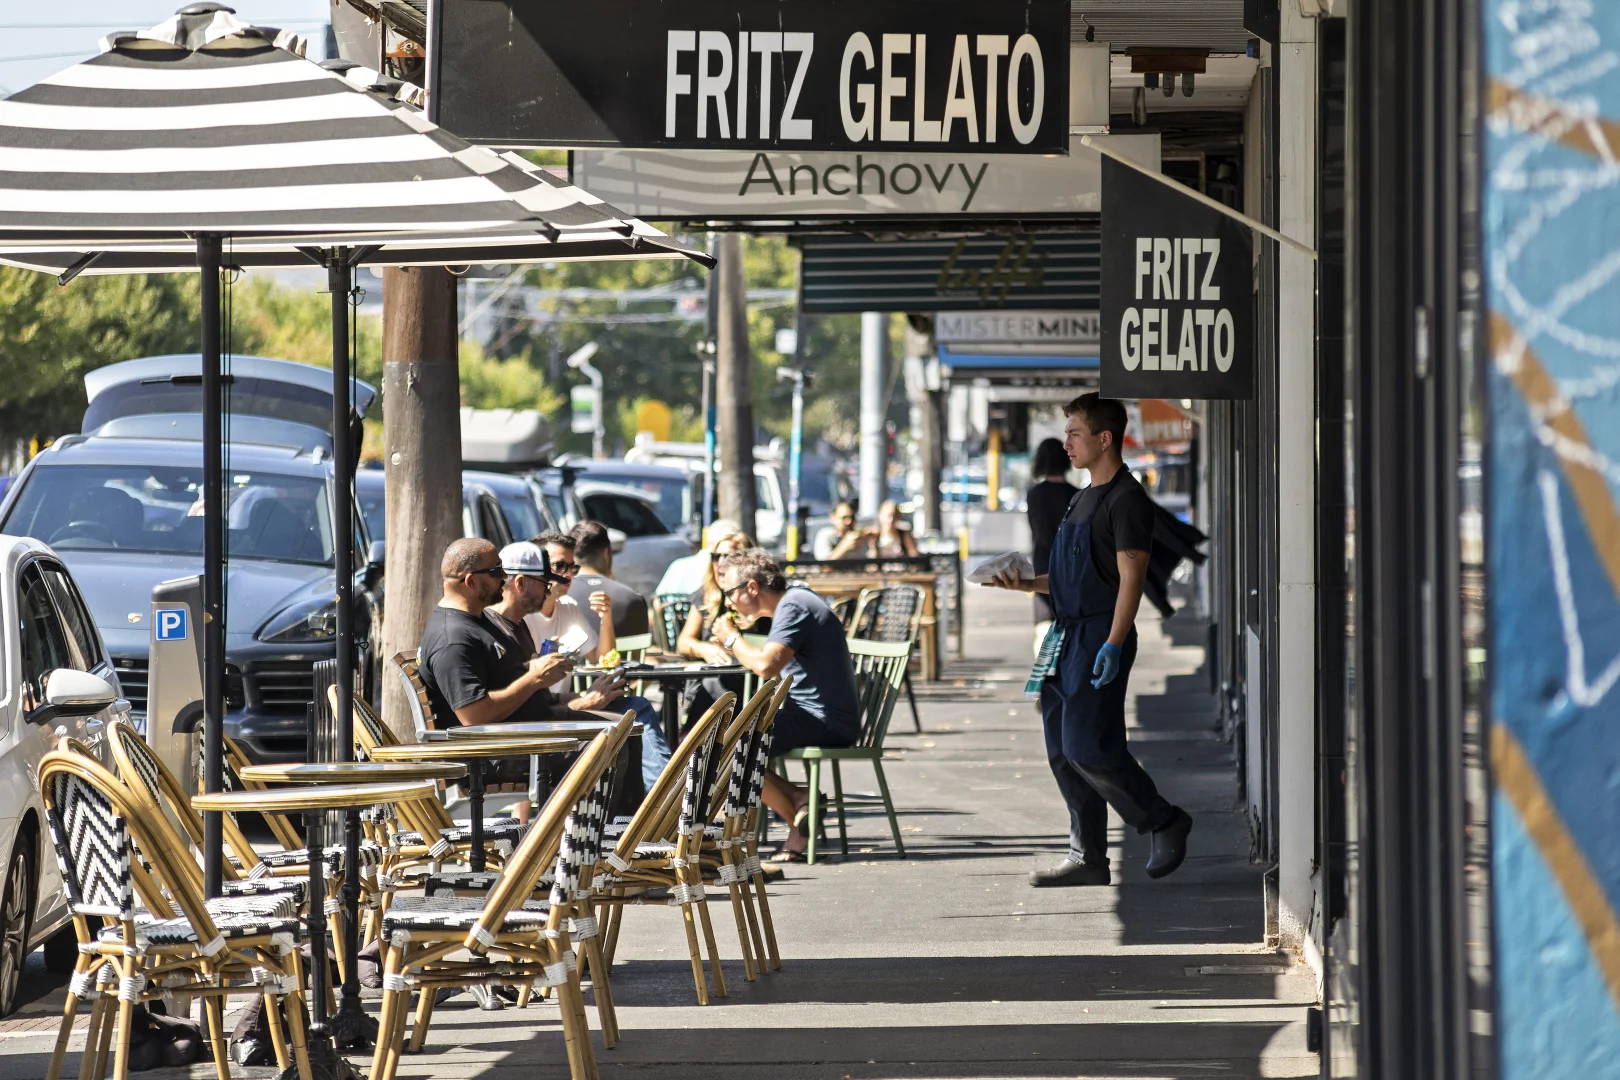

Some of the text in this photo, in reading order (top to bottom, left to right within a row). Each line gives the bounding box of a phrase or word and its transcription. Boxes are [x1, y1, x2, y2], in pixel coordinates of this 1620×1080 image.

[666, 30, 1045, 145] FRITZ GELATO
[738, 152, 989, 211] Anchovy
[1135, 237, 1221, 301] FRITZ
[1120, 307, 1235, 373] GELATO
[161, 612, 181, 637] P
